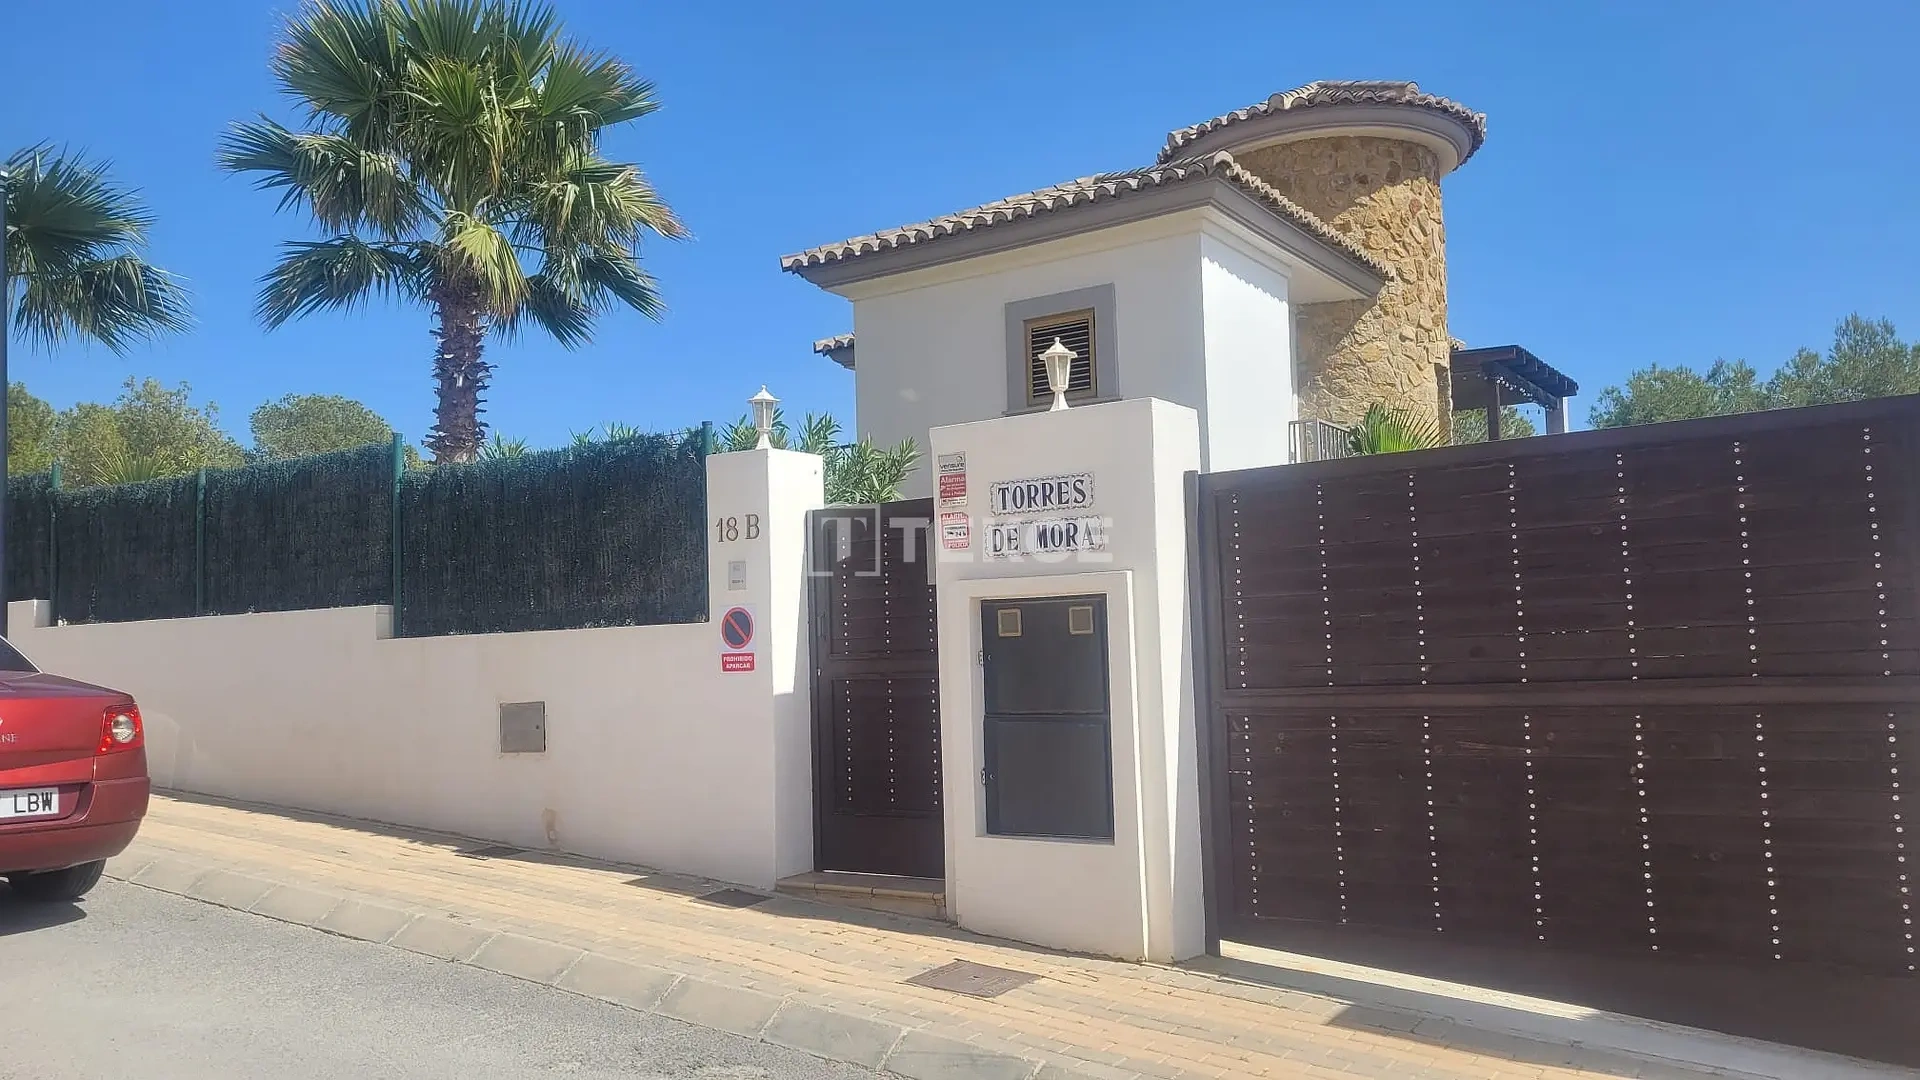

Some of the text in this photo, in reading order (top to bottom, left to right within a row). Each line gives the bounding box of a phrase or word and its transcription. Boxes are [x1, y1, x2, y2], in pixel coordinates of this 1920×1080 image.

[997, 478, 1087, 511] TORRES
[715, 513, 760, 543] 18 B
[993, 522, 1095, 553] DE MORA
[13, 791, 53, 813] LBW
